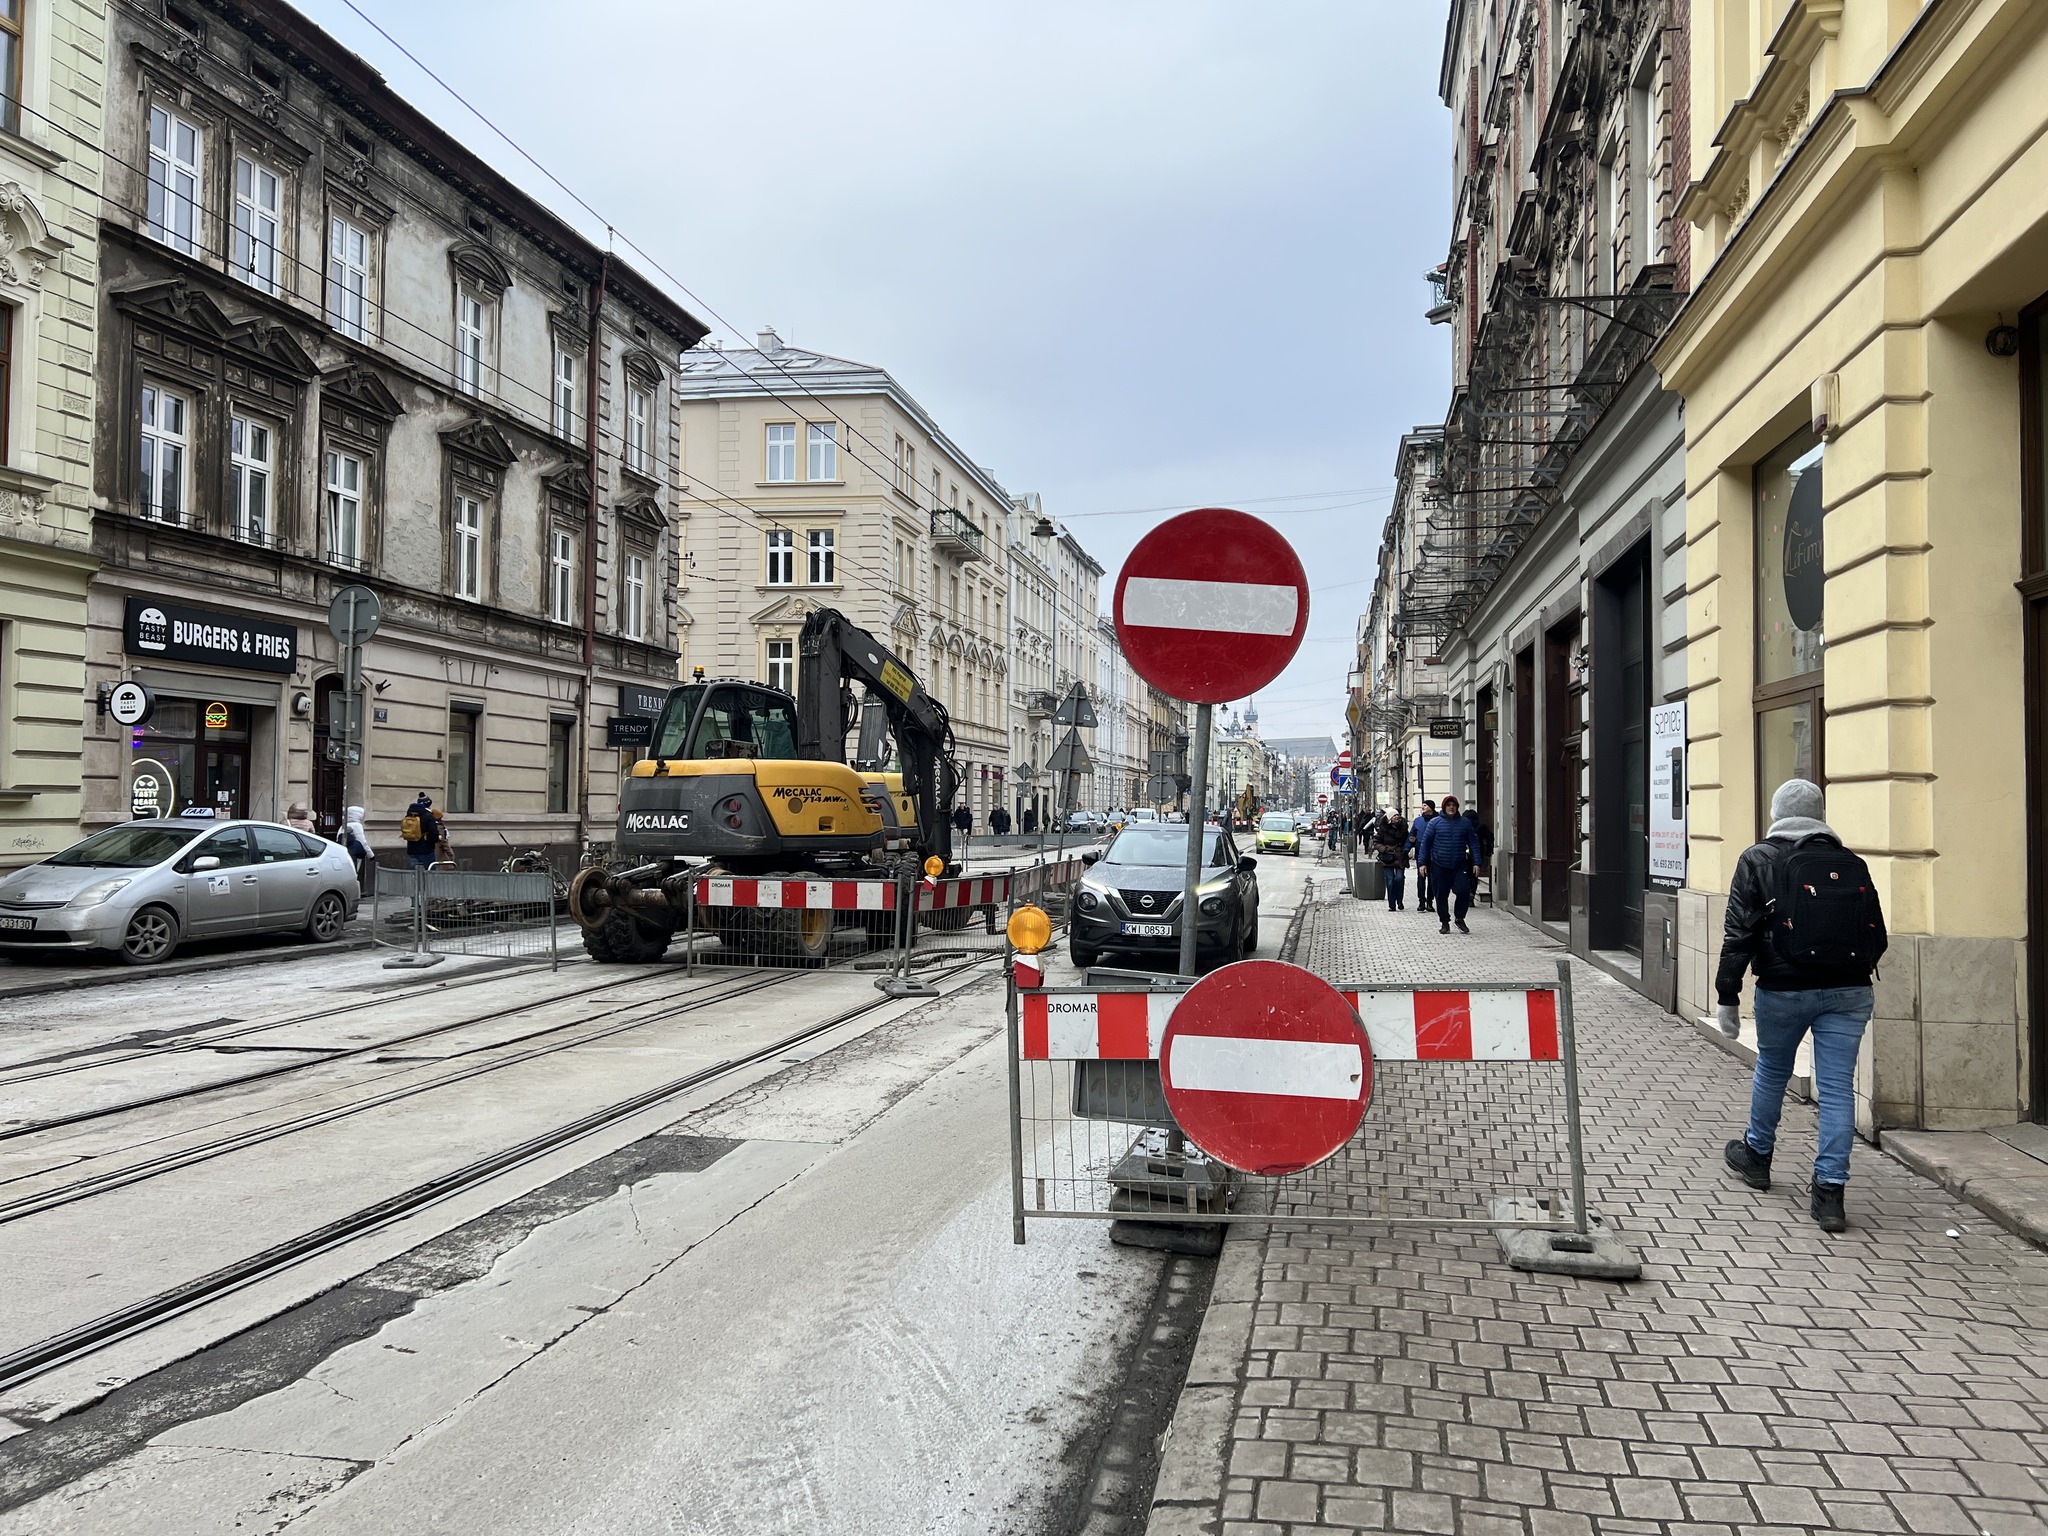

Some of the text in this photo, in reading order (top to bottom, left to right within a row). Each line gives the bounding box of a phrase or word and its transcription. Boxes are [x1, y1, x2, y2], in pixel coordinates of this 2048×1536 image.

[140, 623, 166, 633] TASTY
[139, 632, 166, 642] BEAST
[173, 620, 290, 660] BURGERS & FRIES
[614, 724, 648, 733] TRENDY
[134, 789, 158, 798] TASTY
[133, 798, 158, 806] BEAST
[1144, 925, 1171, 936] 0853J
[1047, 1003, 1098, 1013] DROMAR
